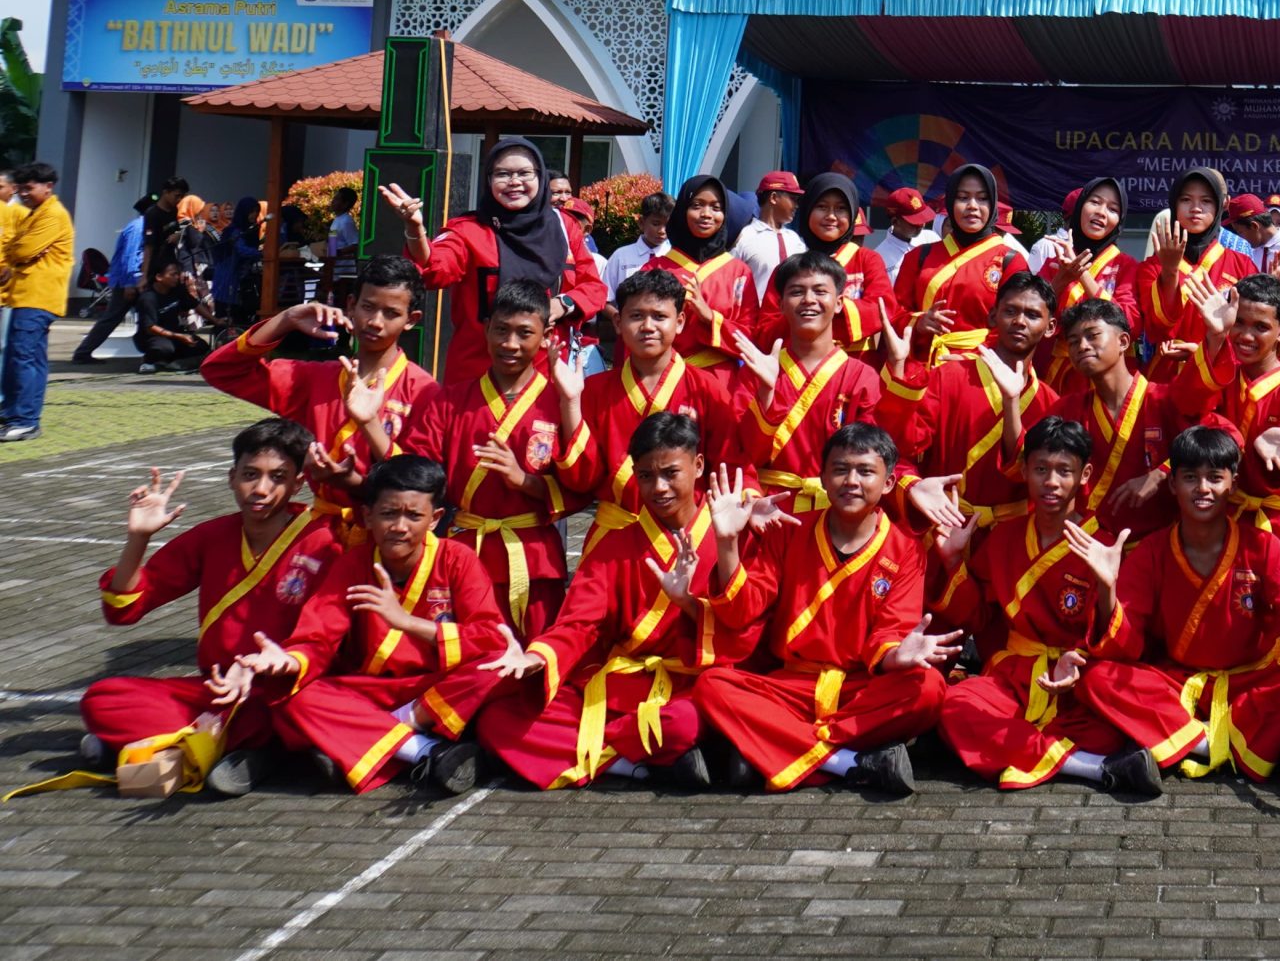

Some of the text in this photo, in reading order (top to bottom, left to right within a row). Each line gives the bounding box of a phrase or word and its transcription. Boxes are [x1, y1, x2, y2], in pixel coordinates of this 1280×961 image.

[234, 0, 277, 16] Putri
[1055, 130, 1173, 151] UPACARA
[1182, 132, 1261, 152] MILAD
